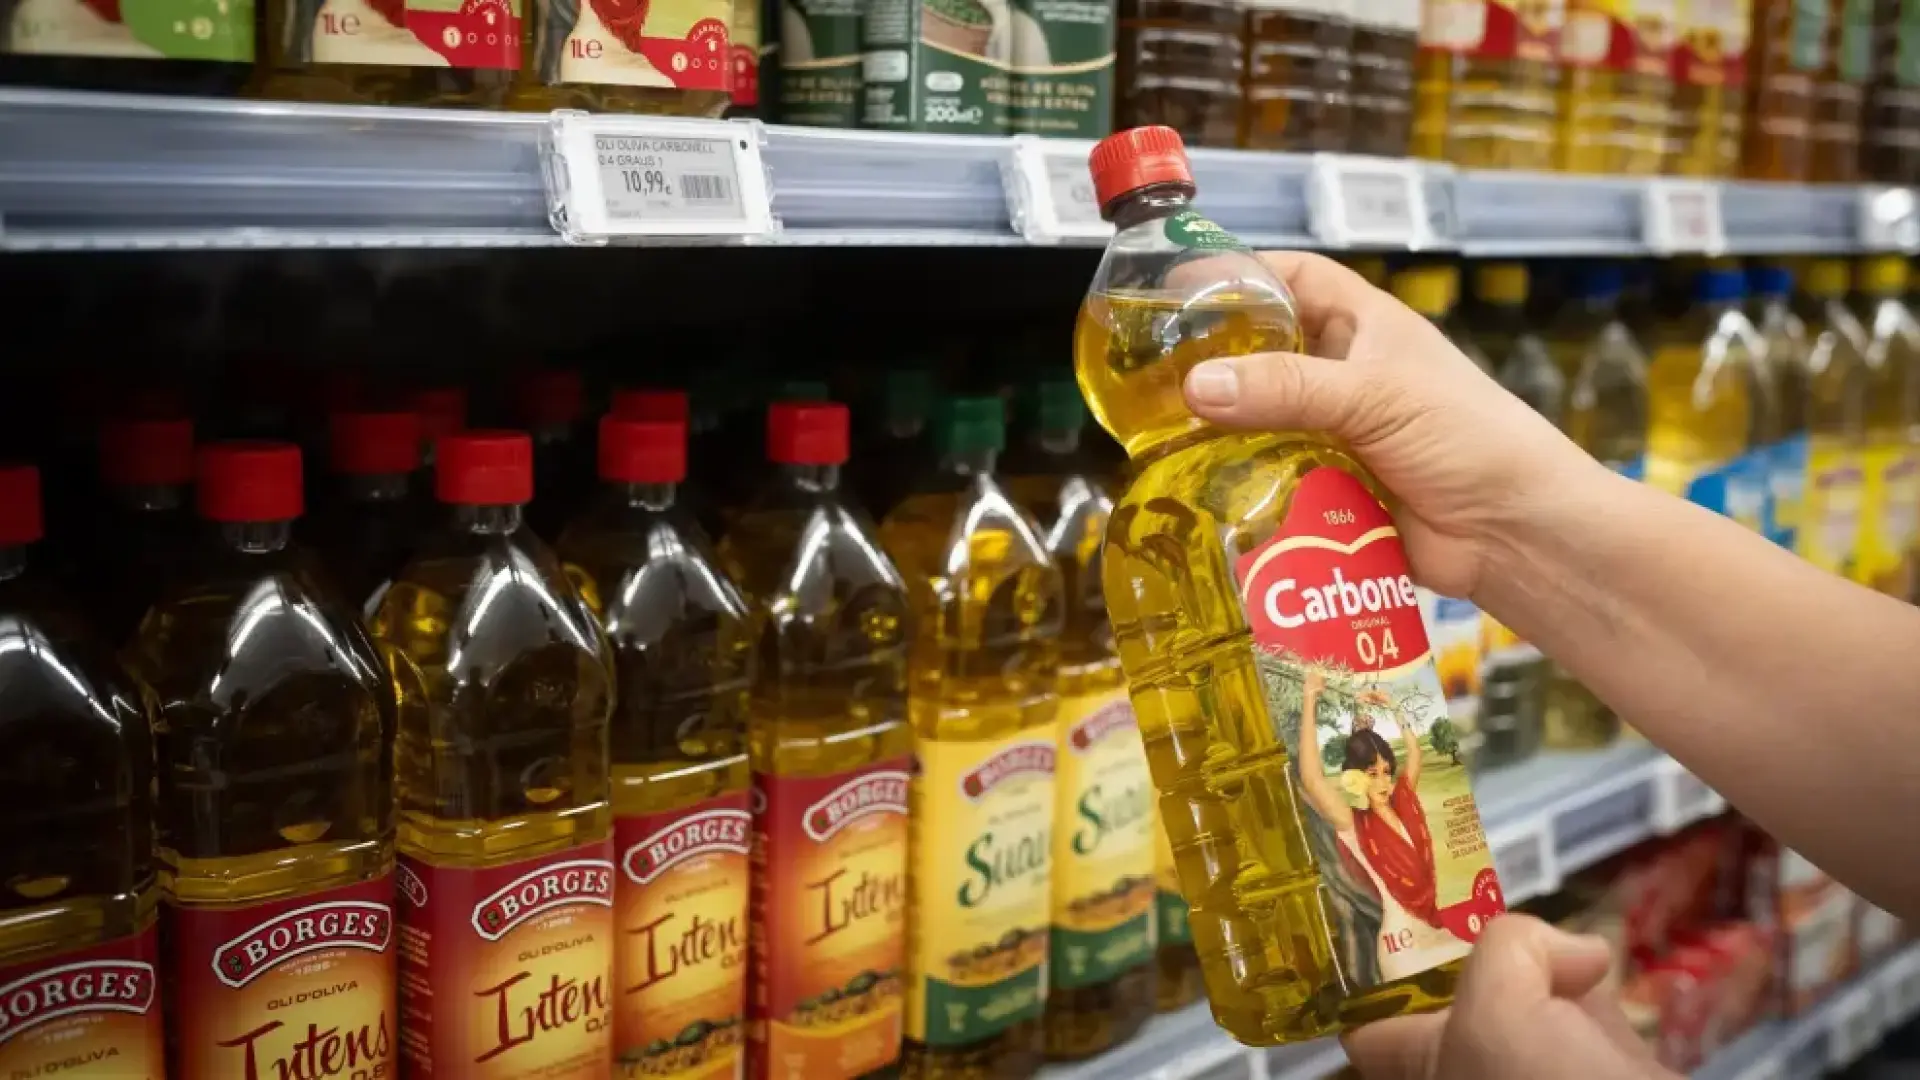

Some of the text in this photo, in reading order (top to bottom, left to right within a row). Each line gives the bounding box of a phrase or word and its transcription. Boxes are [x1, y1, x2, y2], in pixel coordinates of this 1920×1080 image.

[1322, 508, 1356, 525] 1866
[1351, 616, 1392, 629] ORIGINAL
[1355, 628, 1400, 668] 0,4
[648, 818, 747, 865] BORGES
[500, 870, 609, 920] BORGES
[245, 911, 378, 967] BORGES
[267, 979, 359, 1011] OLI D'OLIVA
